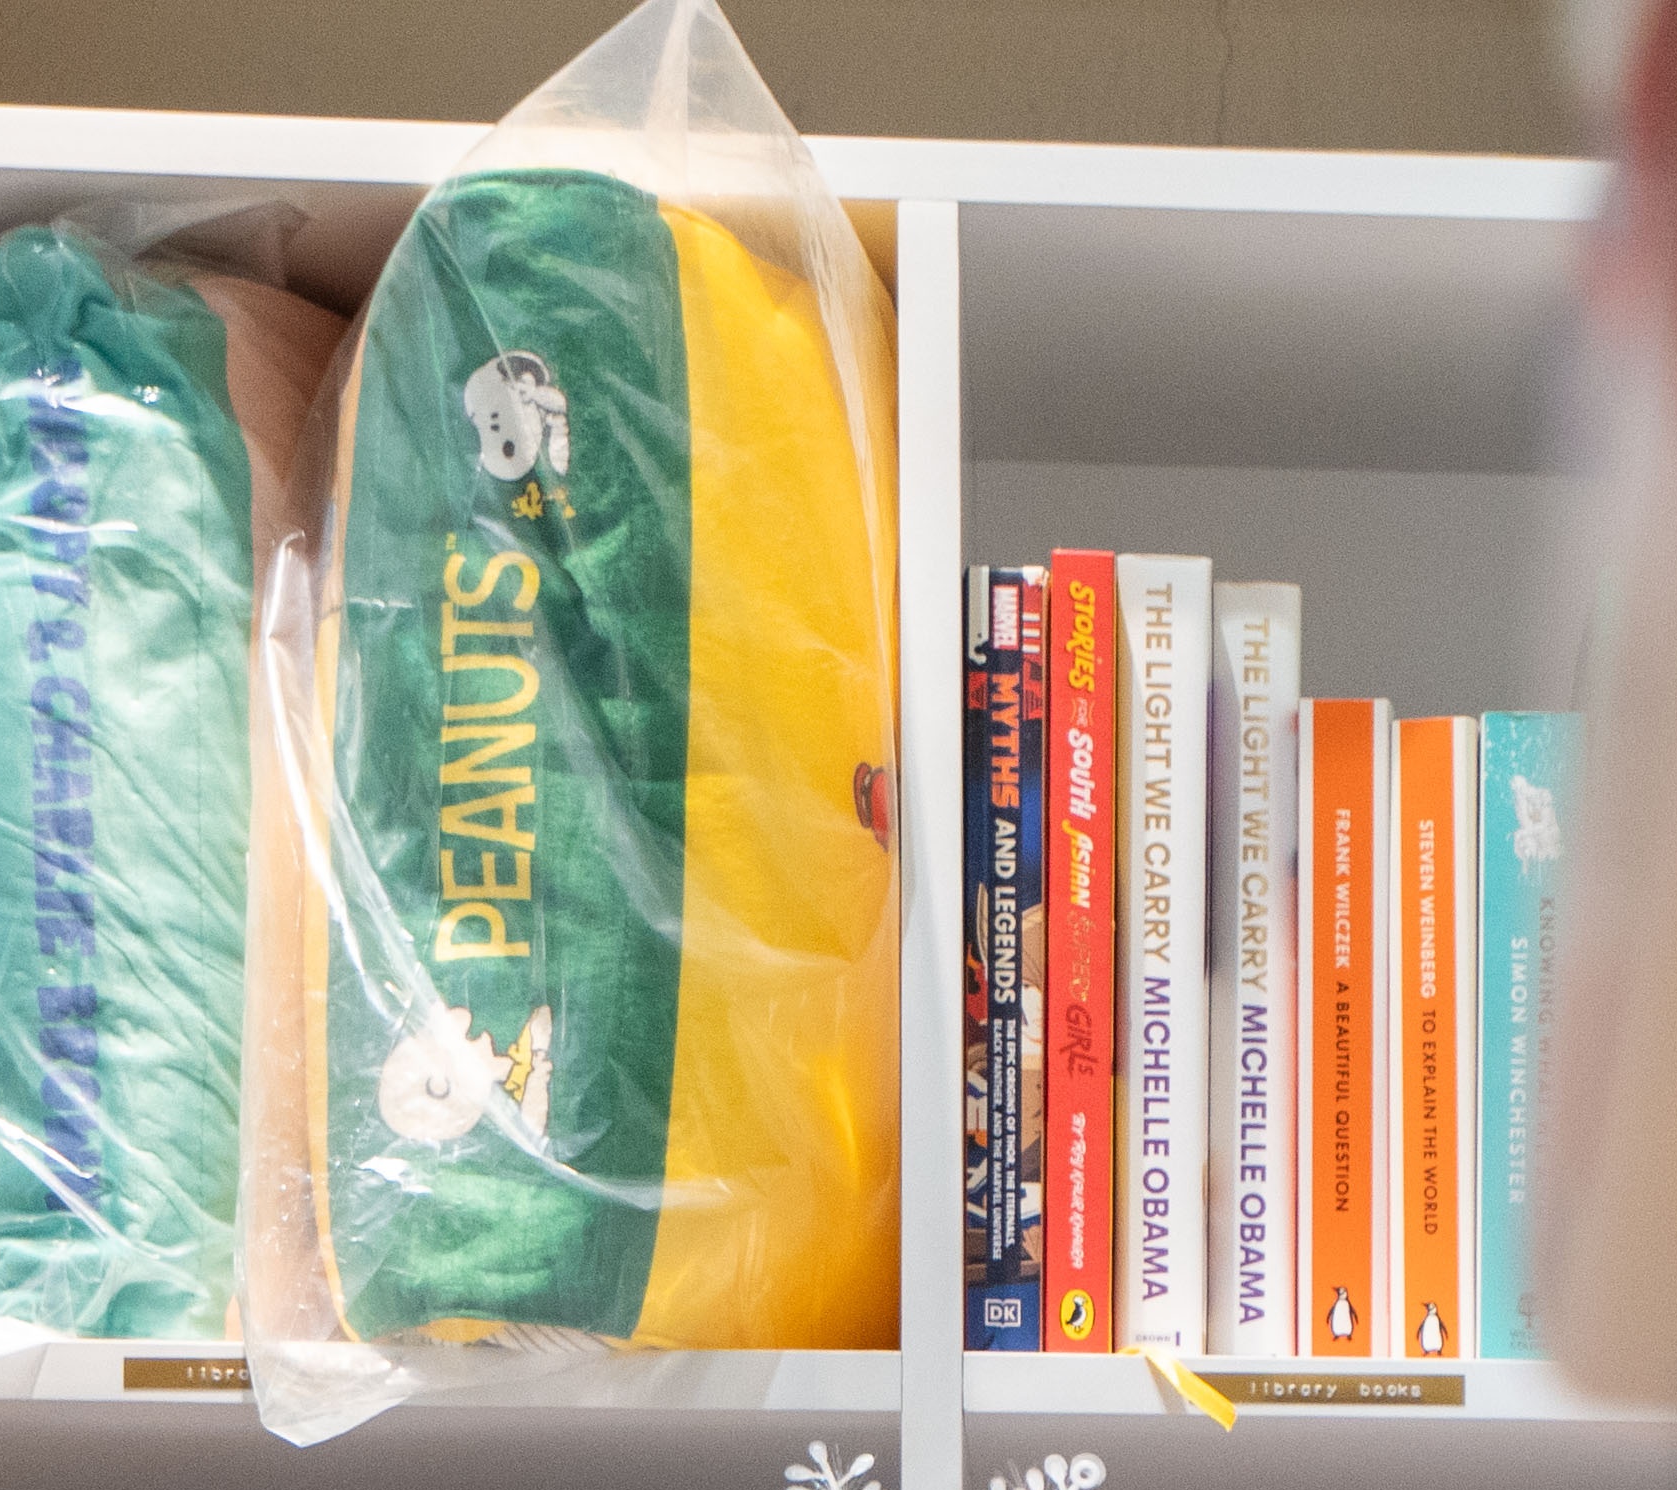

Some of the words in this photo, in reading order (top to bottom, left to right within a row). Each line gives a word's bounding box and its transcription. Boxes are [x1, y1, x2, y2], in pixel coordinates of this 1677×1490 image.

[1145, 582, 1172, 651] THE
[435, 551, 540, 962] PEANUTS
[991, 673, 1020, 808] MYTHS
[1144, 661, 1172, 768] LIGHT
[994, 818, 1016, 879] AND
[1144, 781, 1171, 834] WE
[1419, 819, 1434, 892] STEVEN
[994, 884, 1018, 1004] LEGENDS
[1143, 840, 1172, 965] CARRY
[1420, 897, 1436, 998] WEINBERG
[1142, 976, 1170, 1157] MICHELLE
[1423, 1010, 1436, 1034] TO
[1423, 1041, 1437, 1121] EXPLAIN
[1424, 1126, 1437, 1160] THE
[1142, 1167, 1169, 1300] OBAMA
[1424, 1166, 1438, 1235] WORLD
